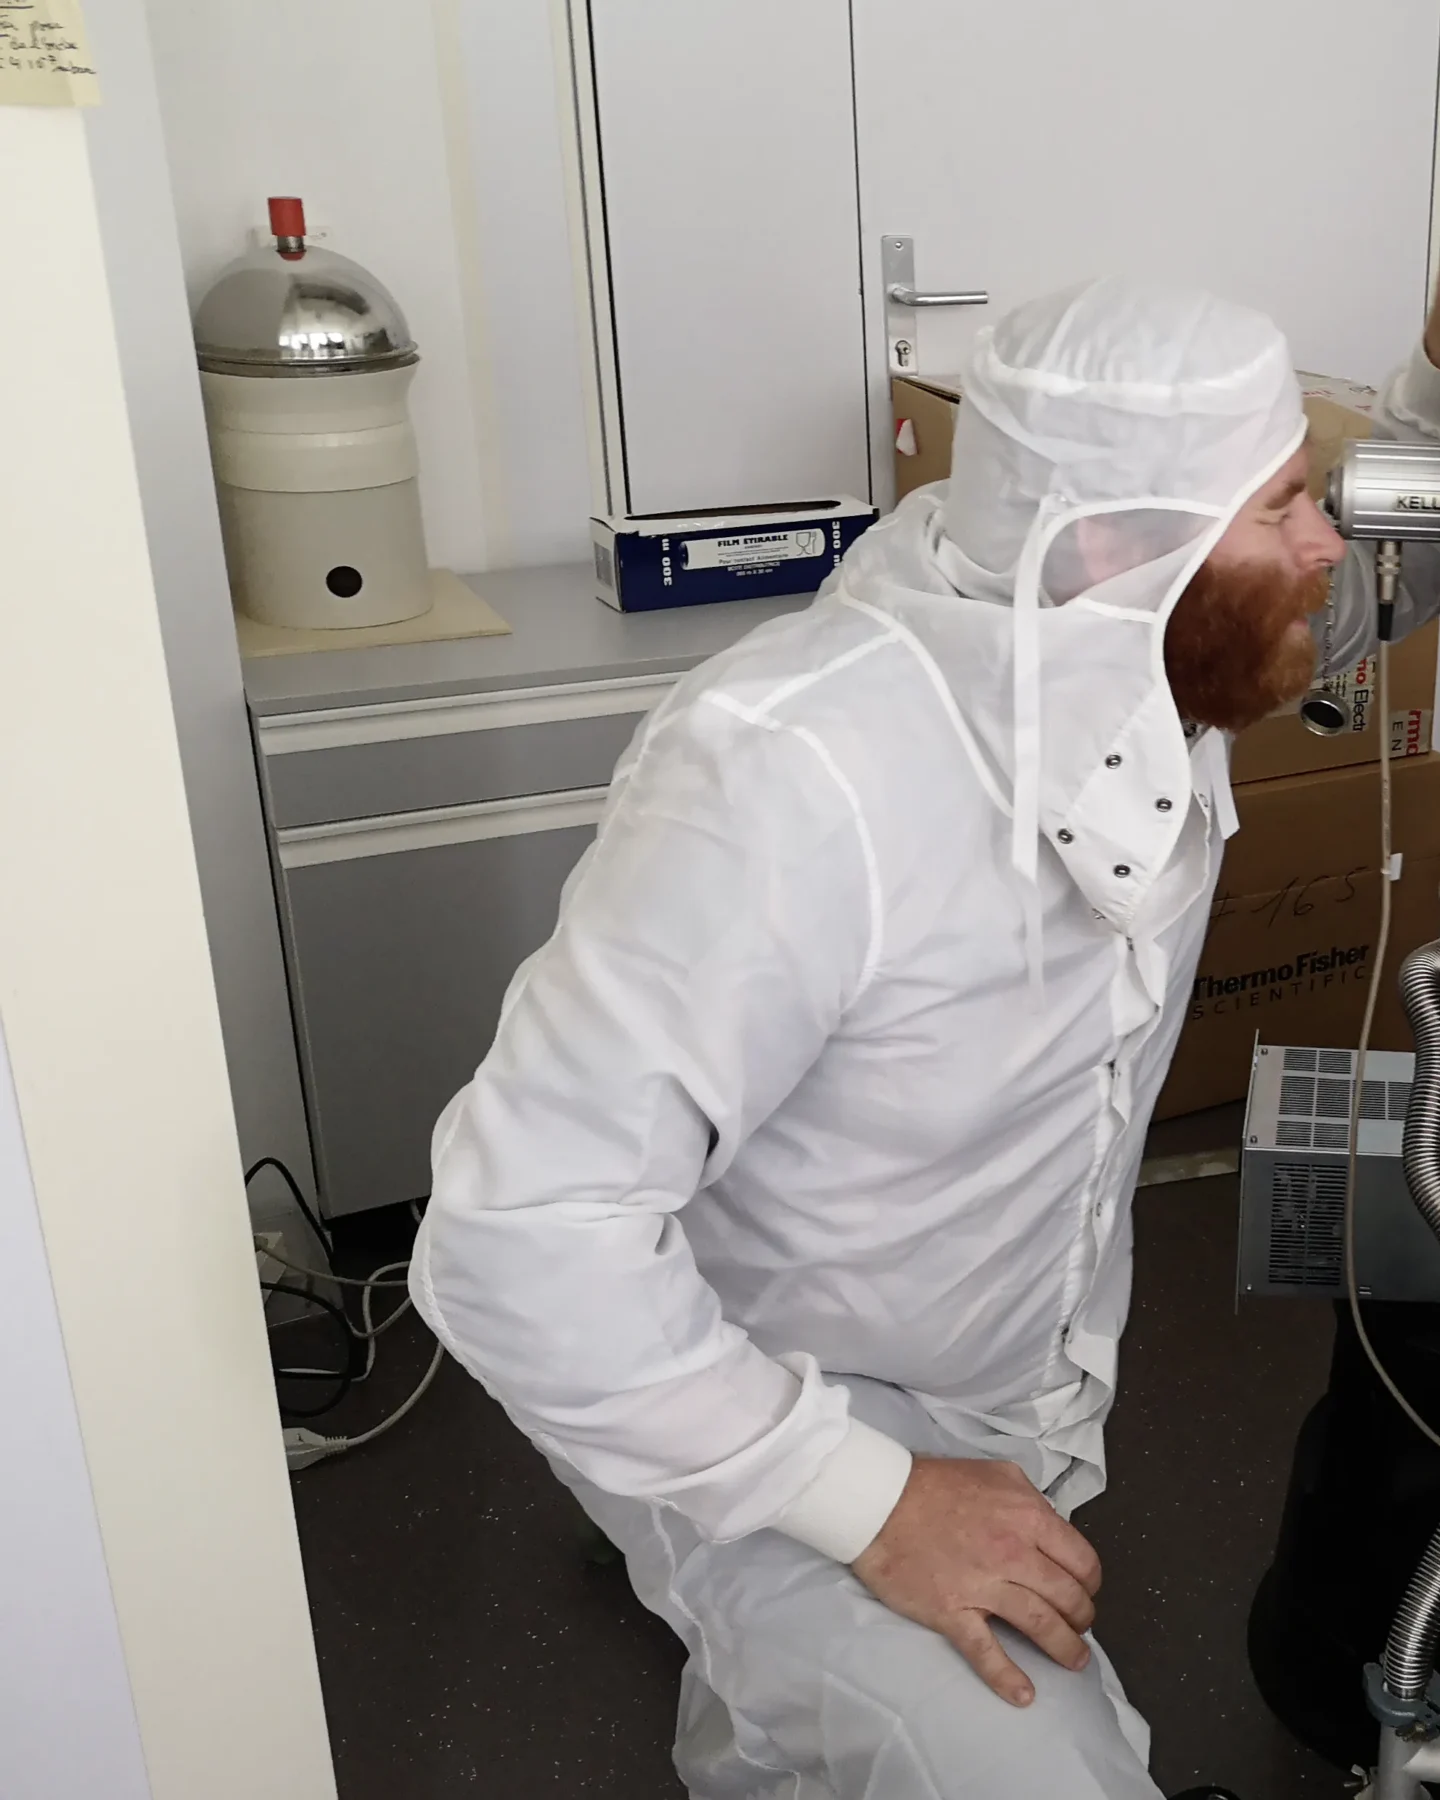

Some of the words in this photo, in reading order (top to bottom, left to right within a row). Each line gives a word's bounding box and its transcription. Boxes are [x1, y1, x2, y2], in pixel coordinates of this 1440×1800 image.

[661, 538, 670, 551] m
[717, 538, 740, 549] FILM
[831, 521, 842, 549] 300
[663, 556, 673, 587] 300
[1251, 866, 1369, 930] 165
[1192, 965, 1366, 1021] SCIENTIFIC
